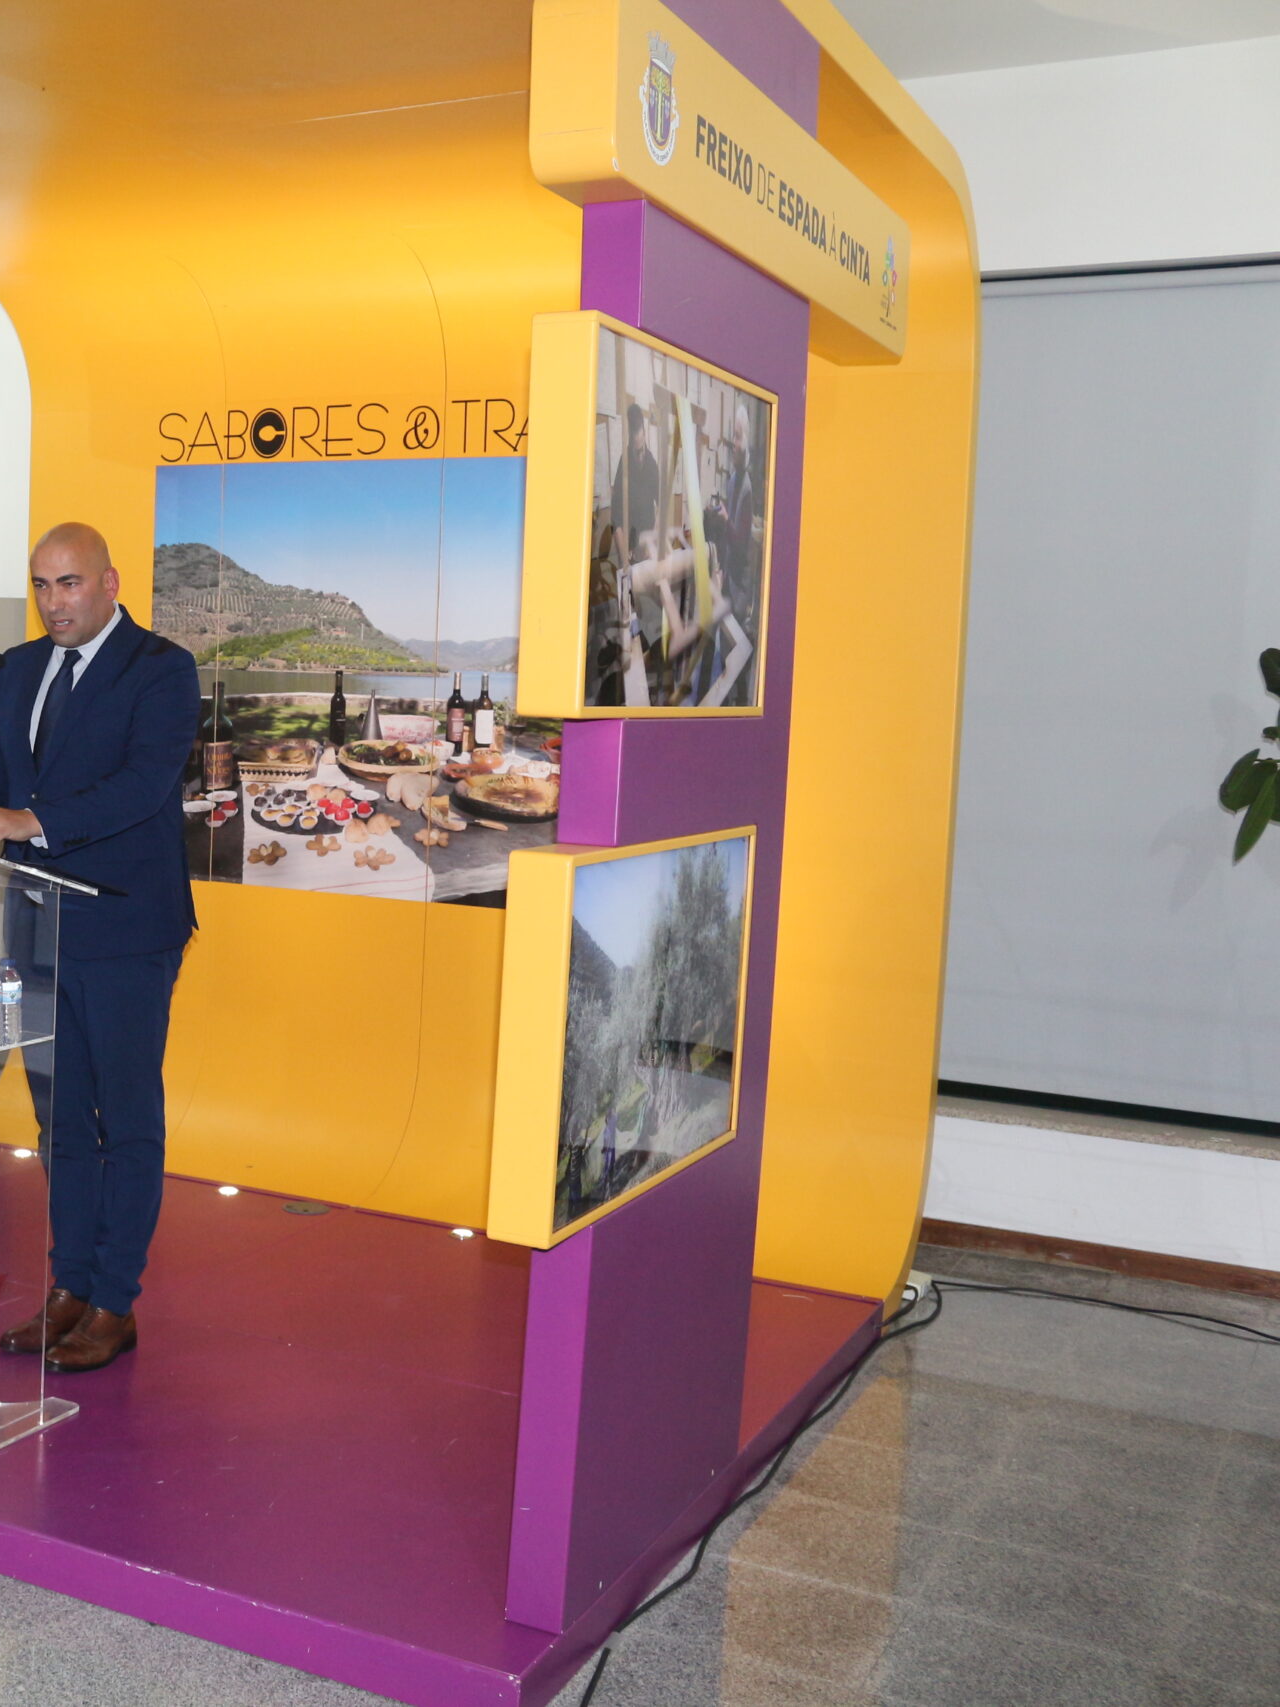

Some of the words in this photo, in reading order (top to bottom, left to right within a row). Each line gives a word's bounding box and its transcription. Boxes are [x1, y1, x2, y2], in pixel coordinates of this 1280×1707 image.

[696, 114, 753, 195] FREIXO
[757, 162, 776, 213] DE
[779, 180, 827, 254] ESPADA
[829, 211, 837, 261] À
[839, 231, 870, 286] CINTA
[159, 403, 389, 463] SABORES
